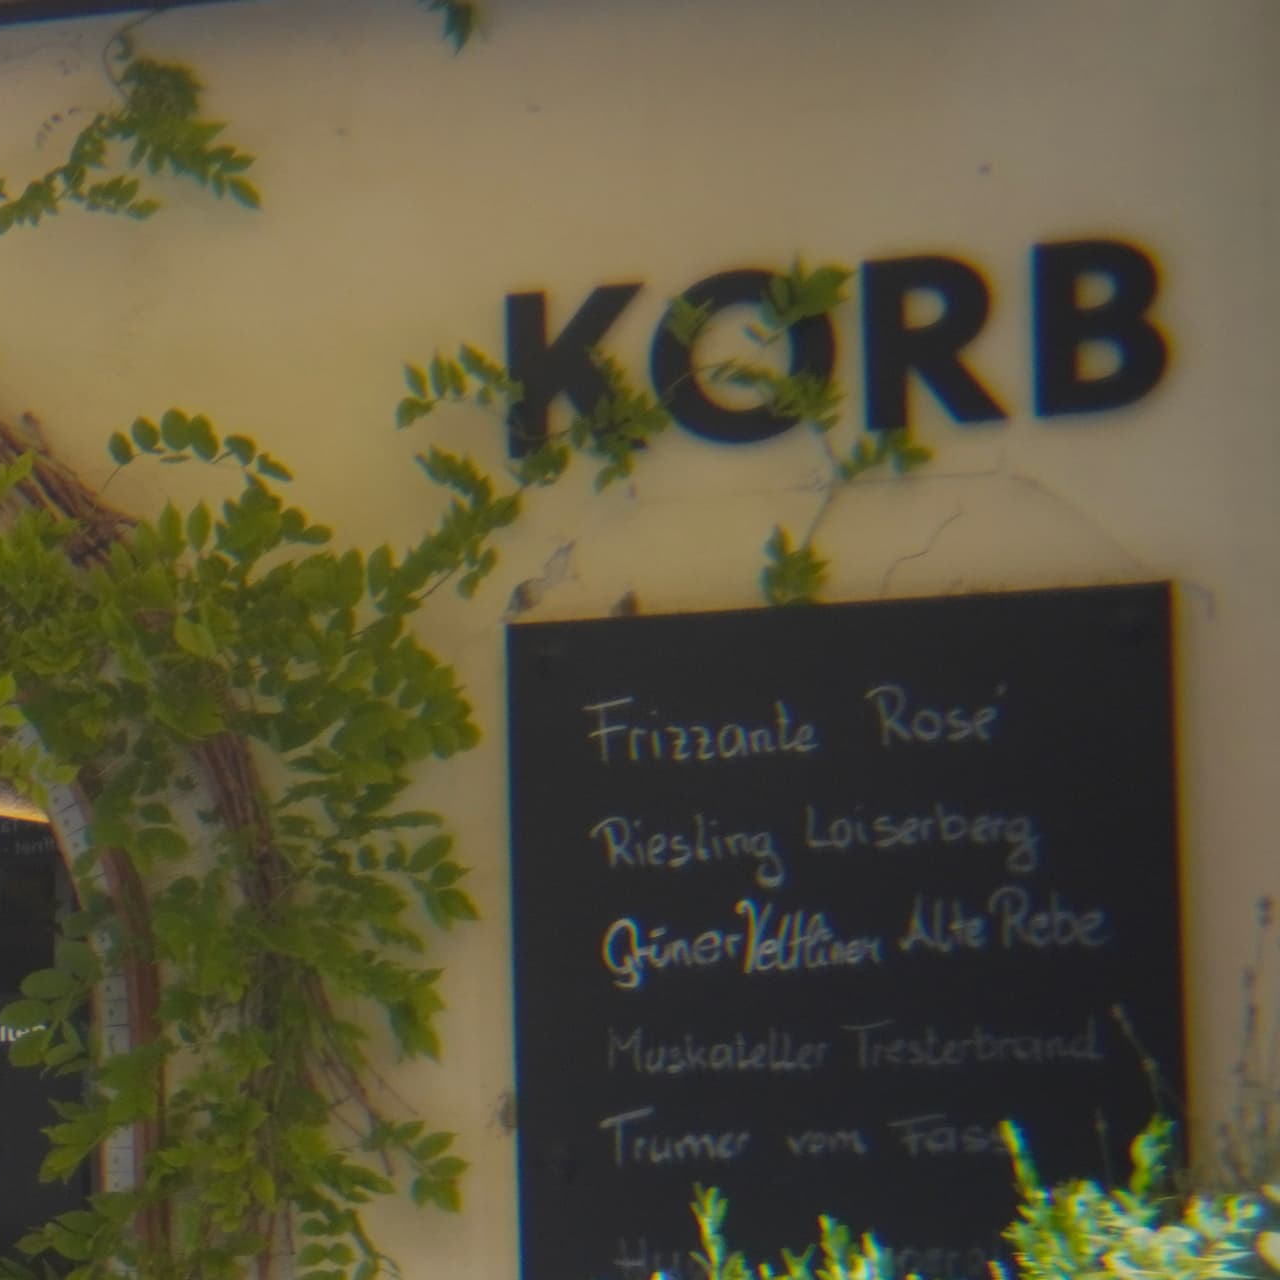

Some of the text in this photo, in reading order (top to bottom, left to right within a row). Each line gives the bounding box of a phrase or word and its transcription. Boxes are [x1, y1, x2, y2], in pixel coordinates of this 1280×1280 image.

[506, 240, 1169, 459] KORB
[585, 683, 1006, 763] Frizzante Rosé
[592, 814, 784, 888] Riesling
[900, 894, 987, 951] Alte
[989, 886, 1106, 947] Rebe
[609, 1027, 831, 1073] Muskateller
[600, 1108, 749, 1167] Trumer
[786, 1127, 868, 1155] vom
